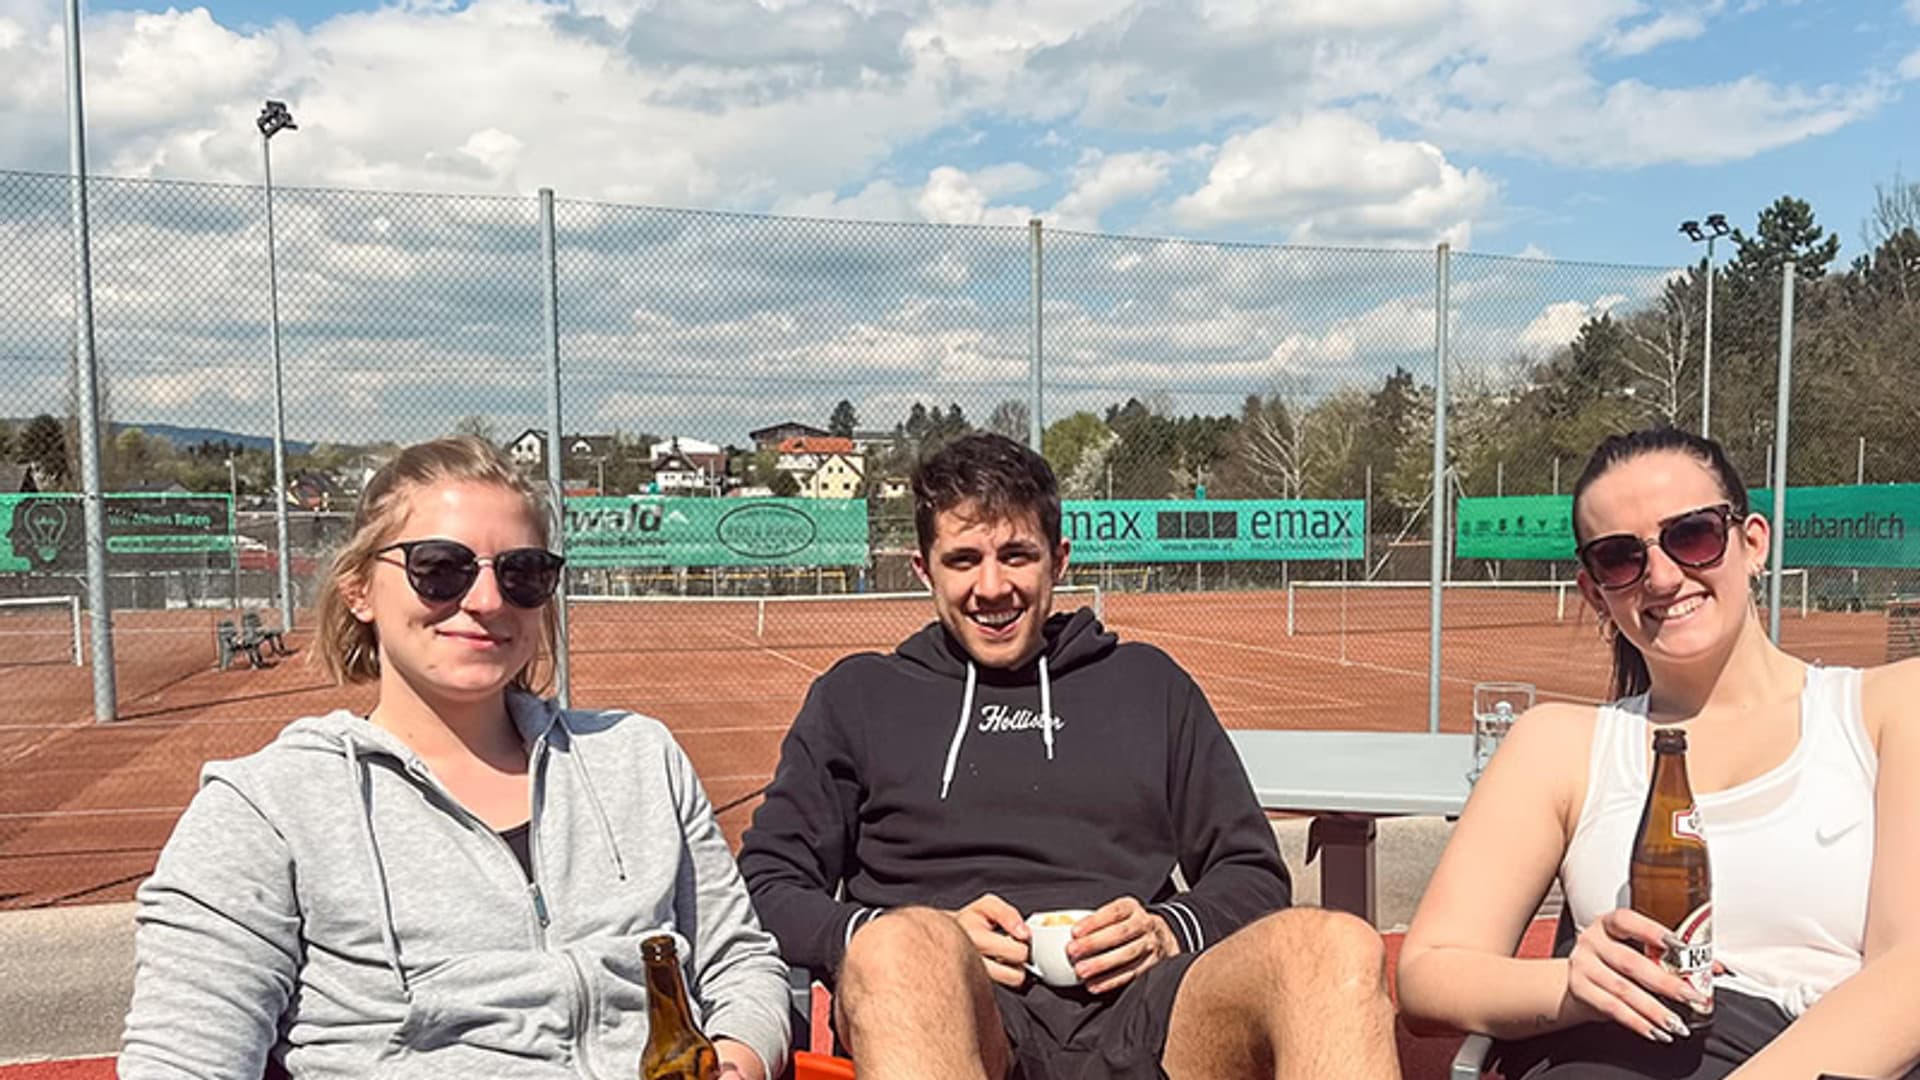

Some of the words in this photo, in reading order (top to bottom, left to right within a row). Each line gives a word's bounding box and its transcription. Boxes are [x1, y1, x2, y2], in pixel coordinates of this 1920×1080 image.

[1061, 510, 1142, 541] max
[1251, 508, 1353, 540] emax
[1783, 511, 1905, 540] aubandich
[979, 704, 1066, 732] Hollisr
